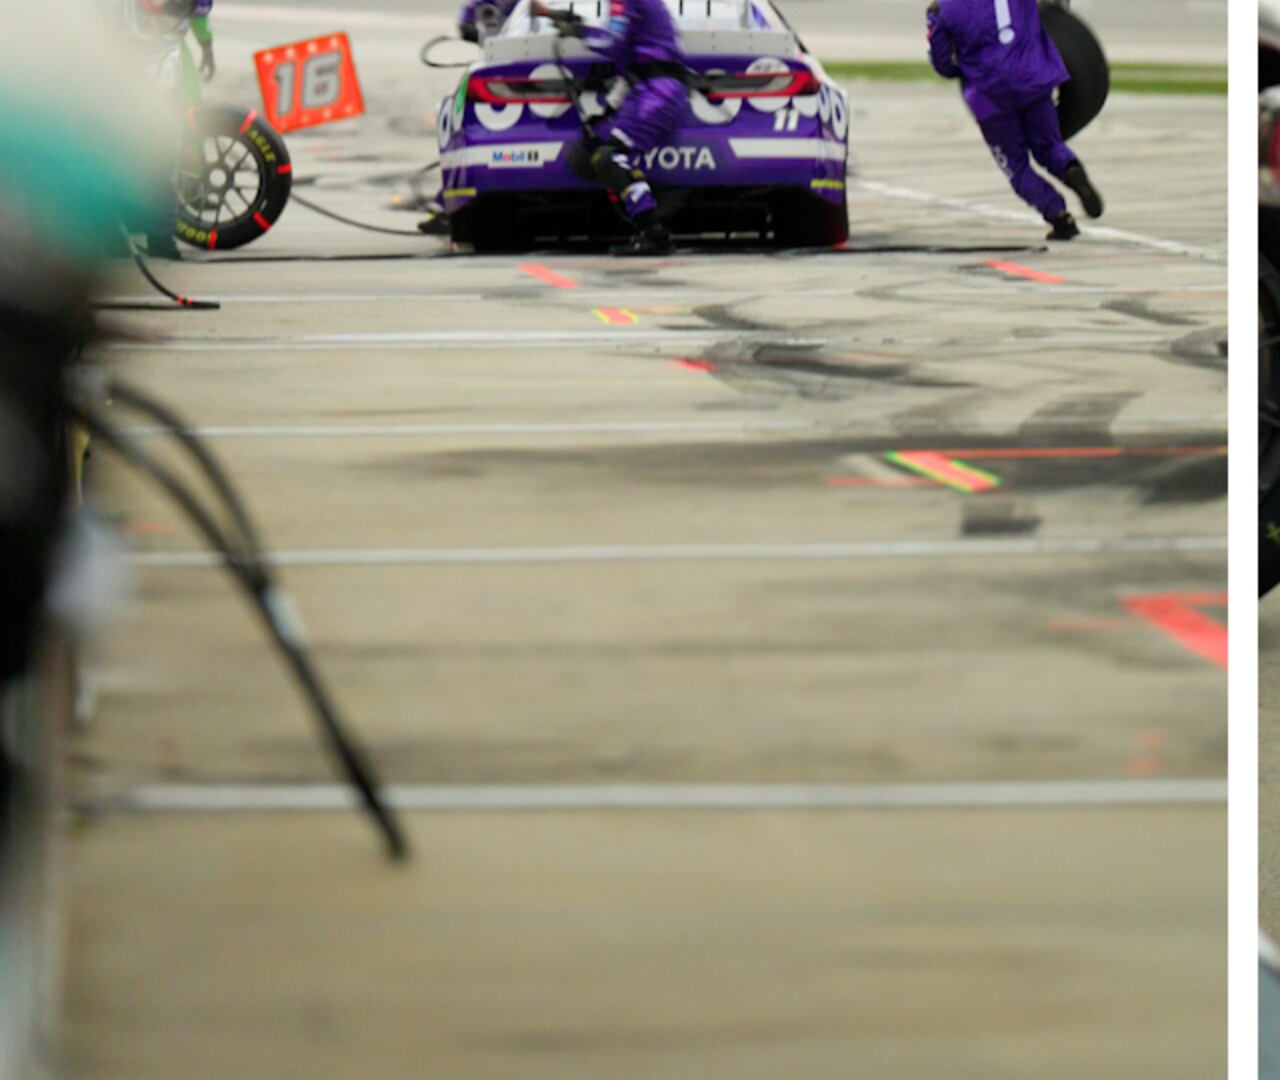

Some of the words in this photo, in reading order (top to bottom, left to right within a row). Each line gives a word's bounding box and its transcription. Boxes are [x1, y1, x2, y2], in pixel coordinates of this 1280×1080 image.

[273, 52, 342, 117] 16
[774, 108, 800, 132] 11
[249, 129, 276, 163] AGLE
[492, 151, 525, 163] Mobil
[632, 146, 716, 170] YOTA
